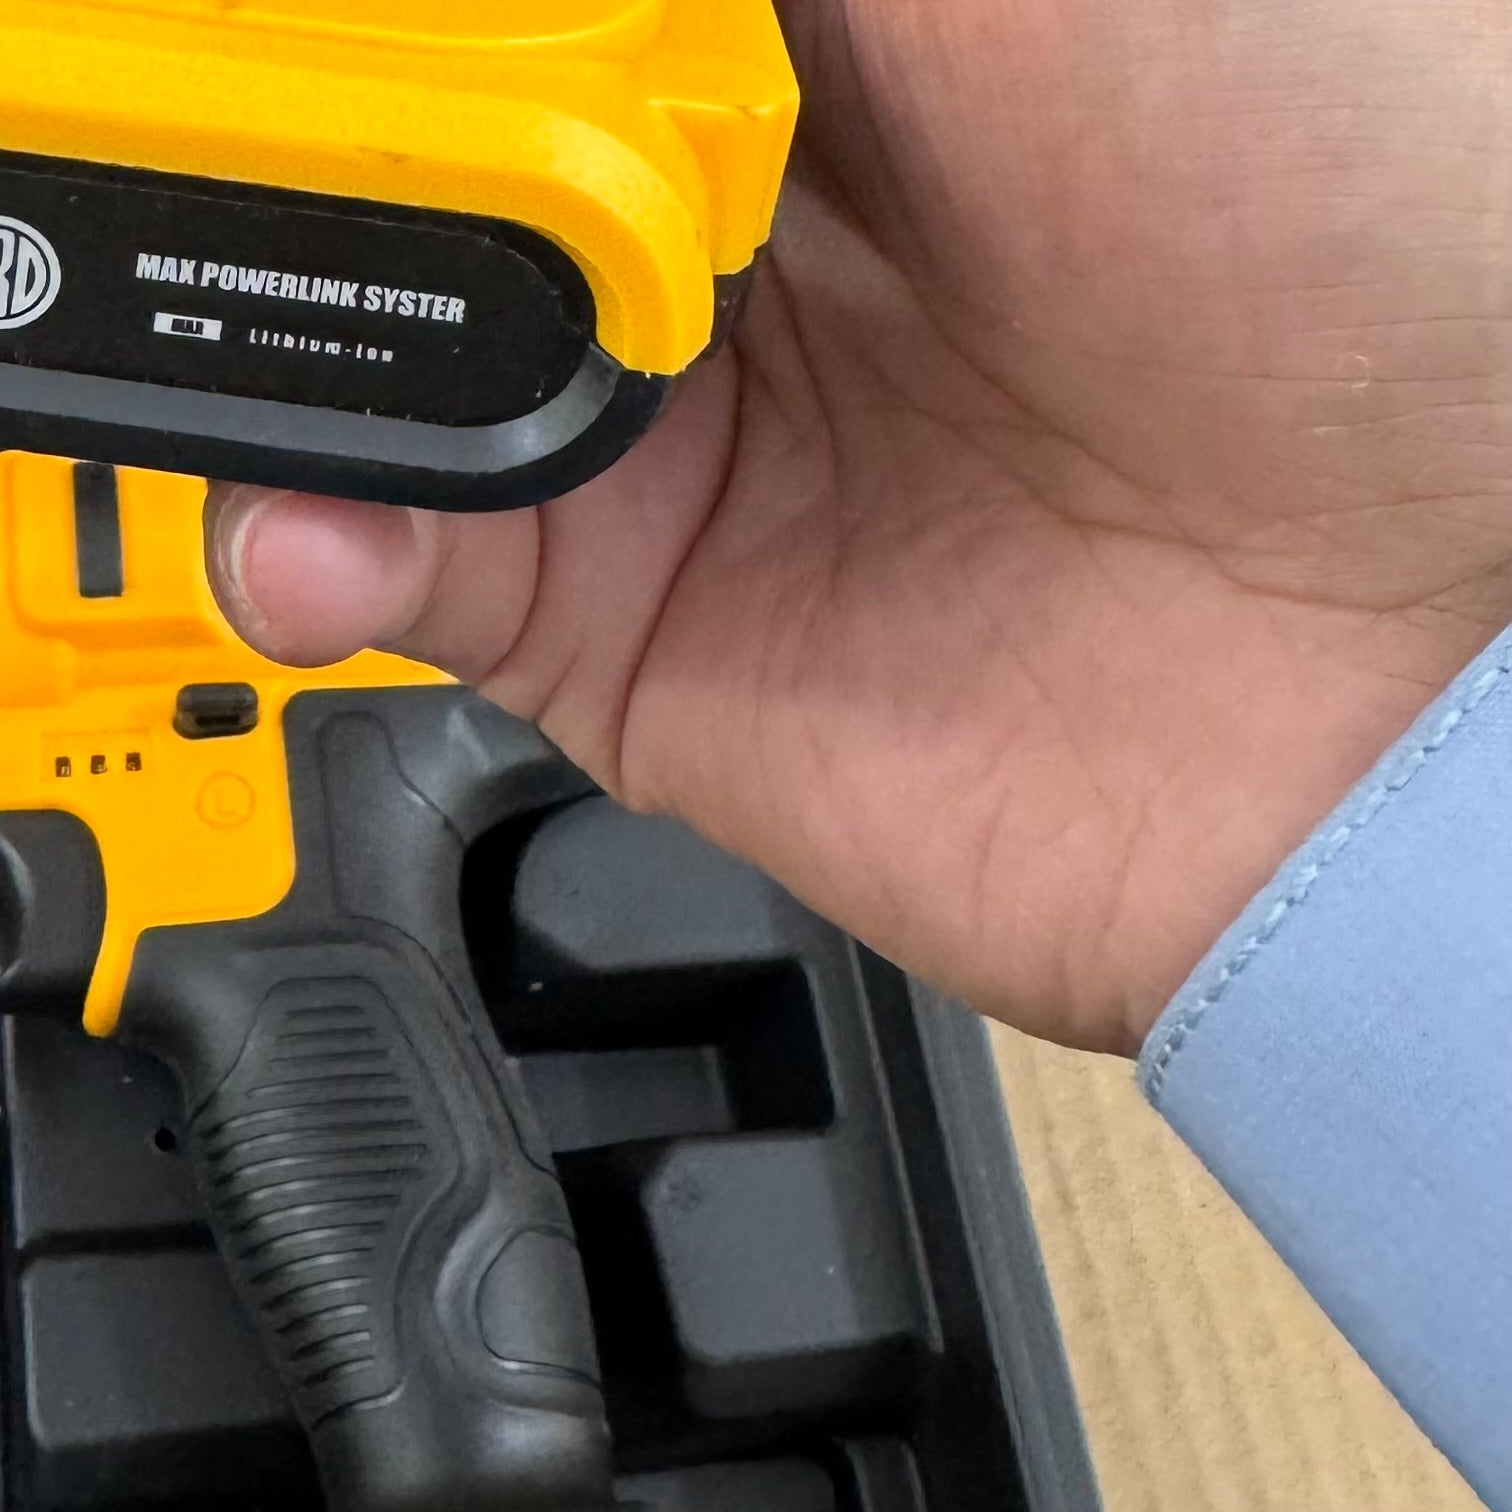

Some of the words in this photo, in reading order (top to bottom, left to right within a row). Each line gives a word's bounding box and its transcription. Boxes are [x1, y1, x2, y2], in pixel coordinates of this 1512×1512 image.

[134, 252, 197, 287] MAX
[199, 260, 360, 308] POWERLINK
[363, 284, 467, 324] SYSTER
